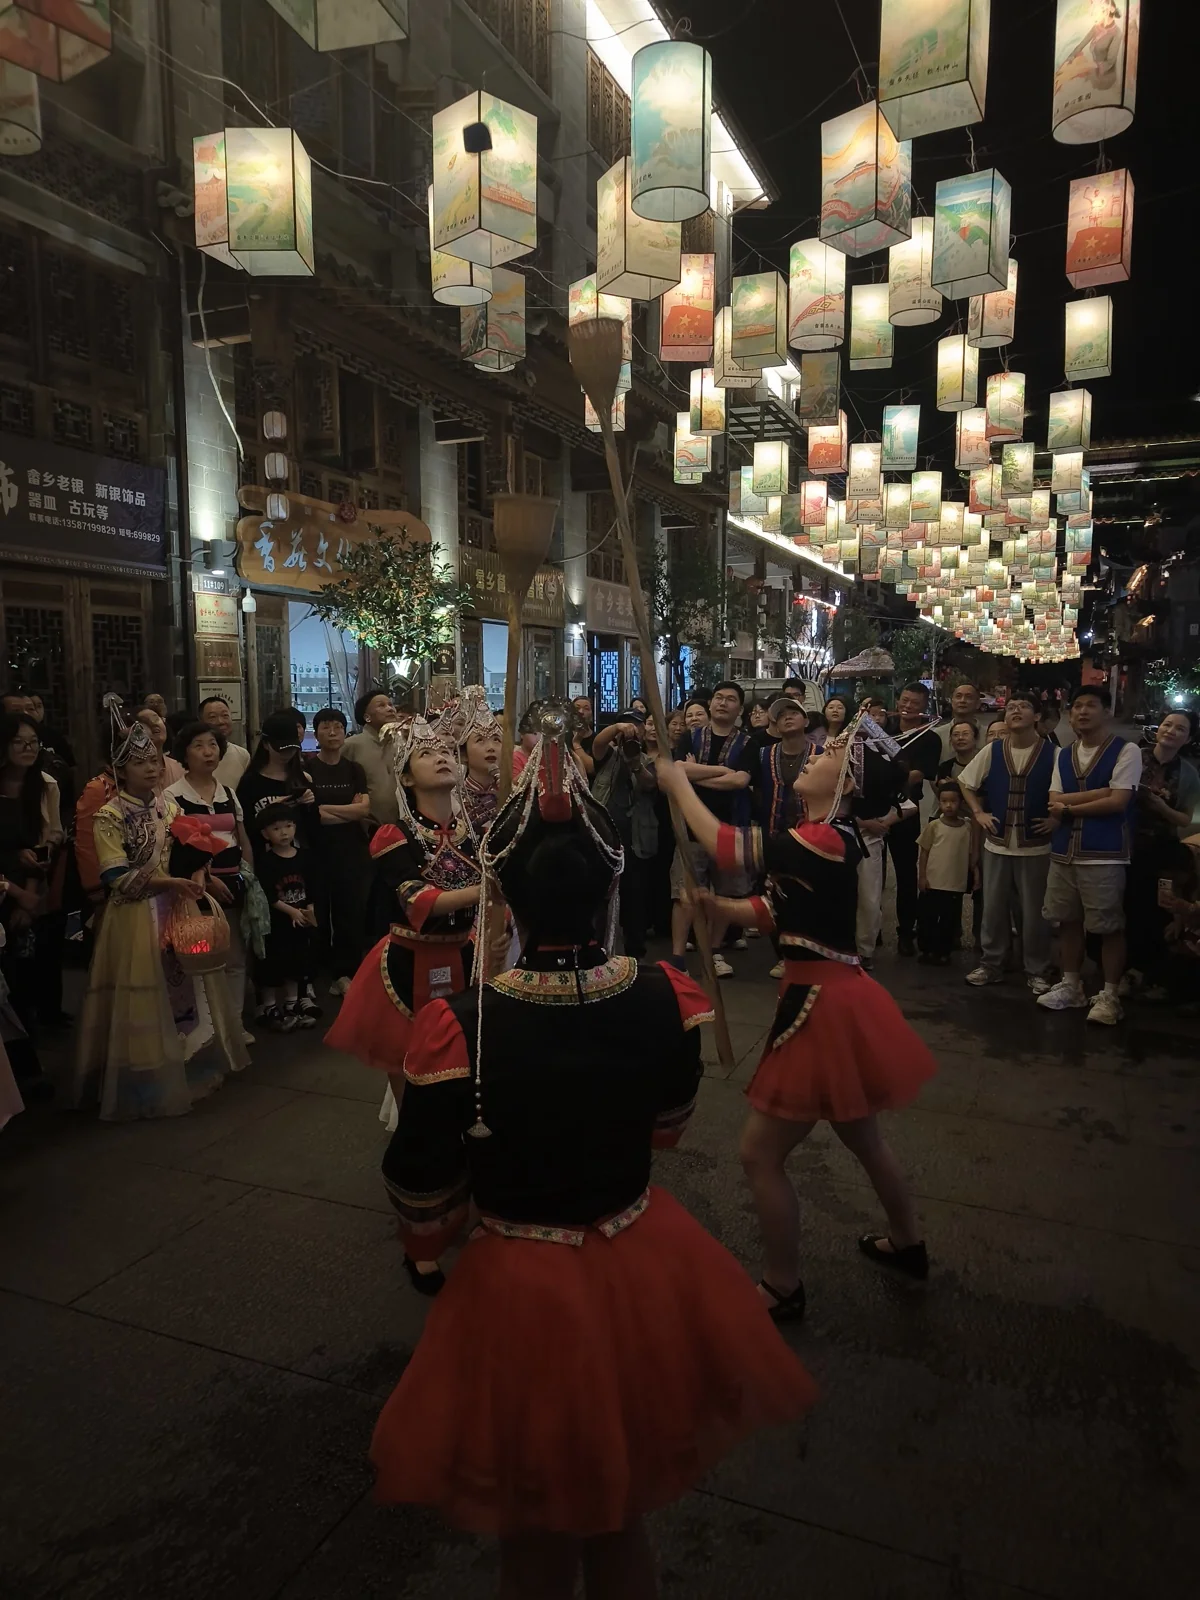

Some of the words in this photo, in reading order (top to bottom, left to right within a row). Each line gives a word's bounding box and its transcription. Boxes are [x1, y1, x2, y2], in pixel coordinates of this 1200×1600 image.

[27, 468, 84, 495] 畲乡老银
[95, 482, 146, 507] 新银饰品
[28, 491, 57, 511] 器皿
[69, 499, 109, 521] 古玩等
